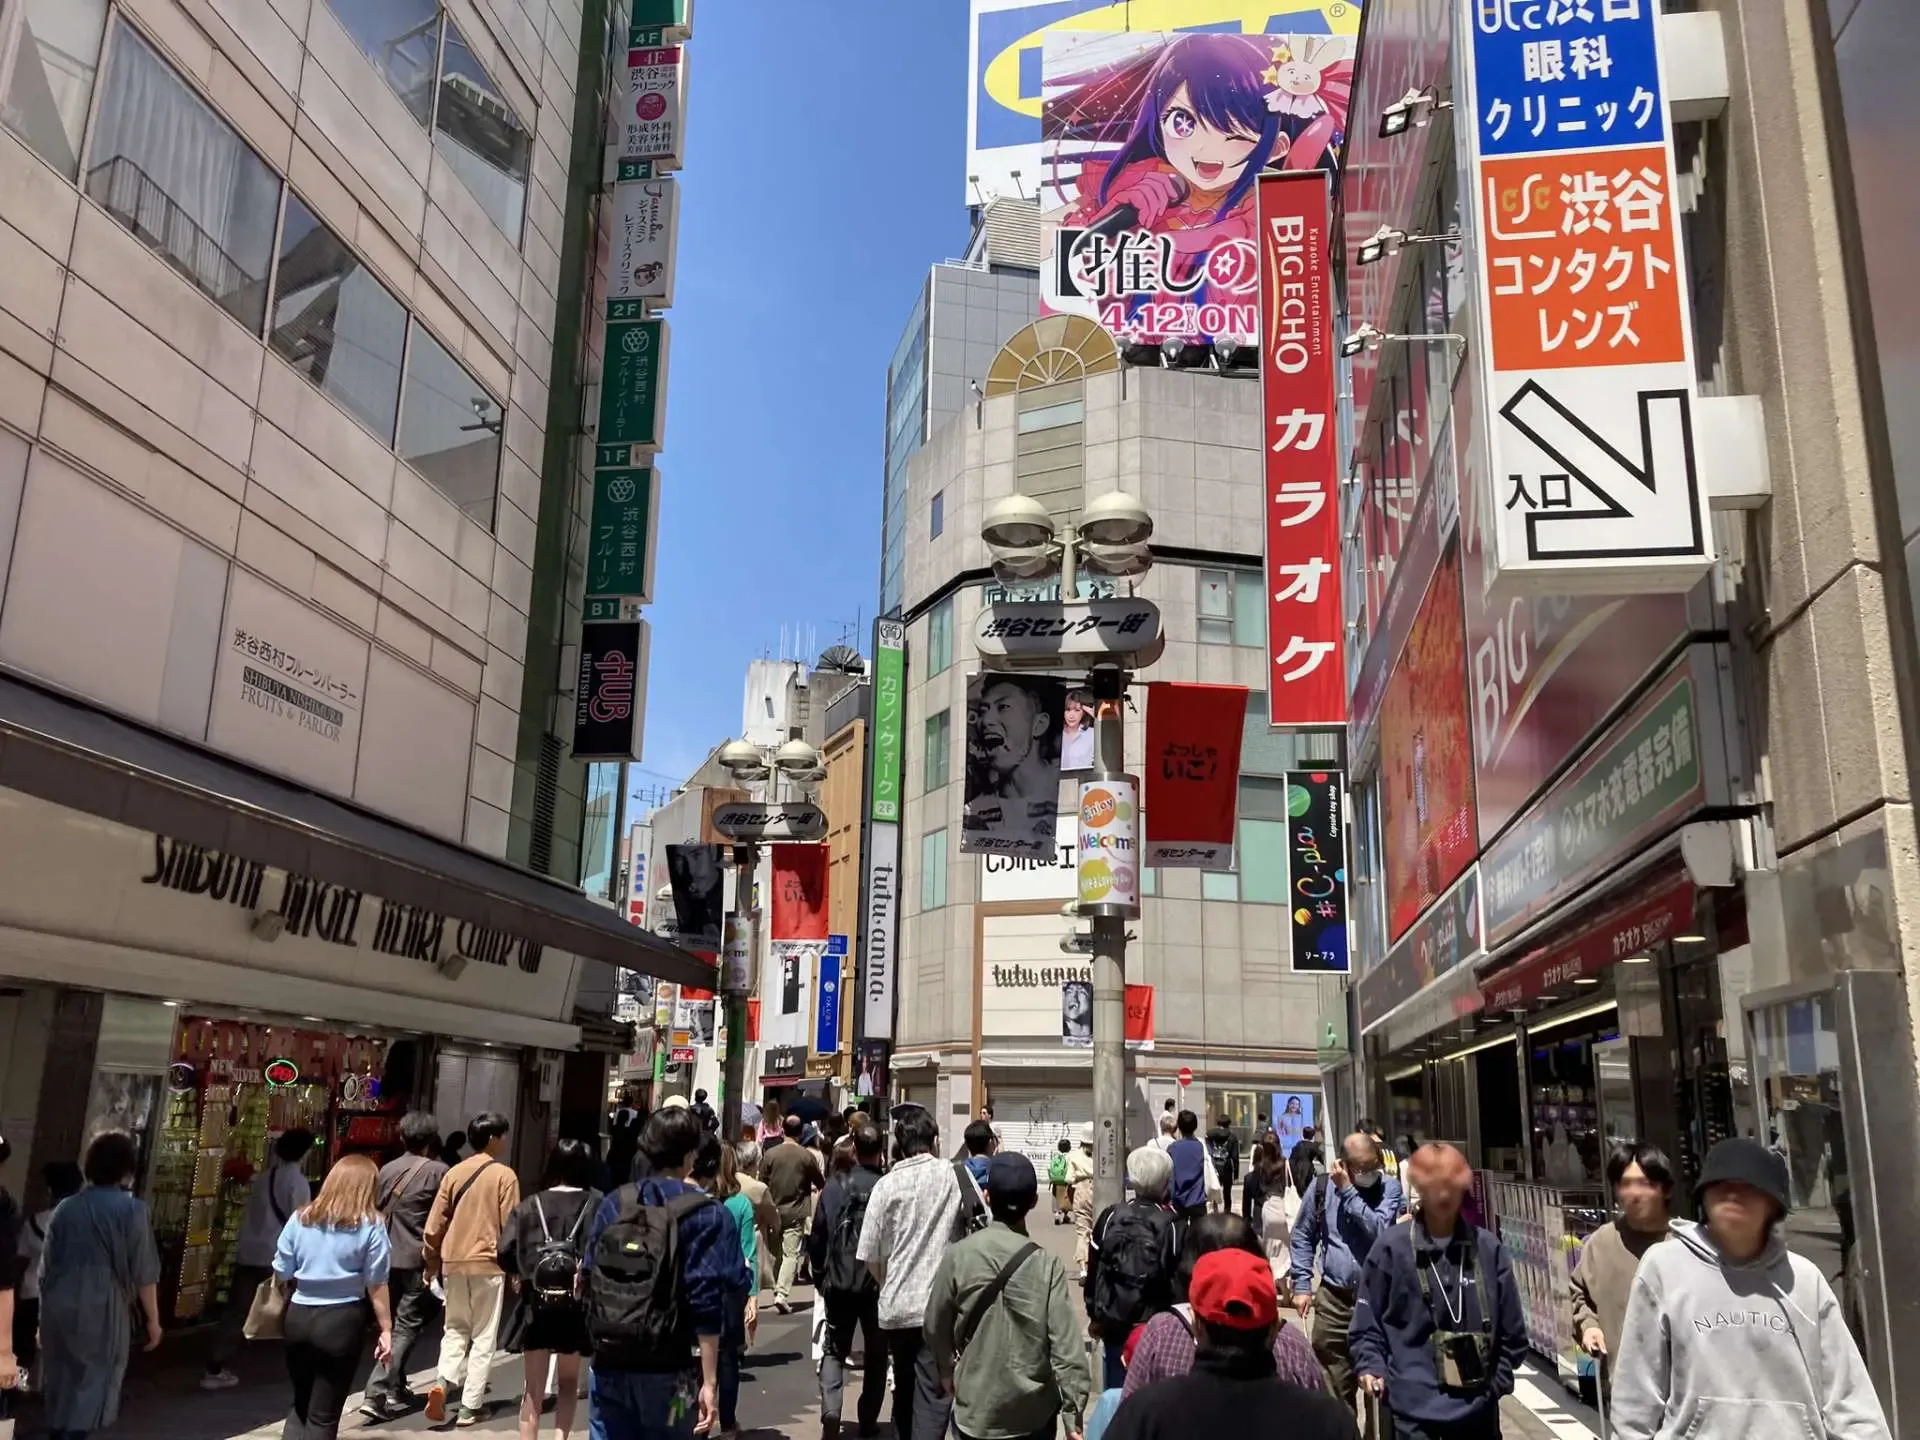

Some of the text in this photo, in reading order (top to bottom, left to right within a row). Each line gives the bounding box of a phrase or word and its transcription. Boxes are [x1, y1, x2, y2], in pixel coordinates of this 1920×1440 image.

[635, 32, 659, 45] 4F
[1523, 35, 1613, 82] 眼科
[631, 67, 659, 80] 渋谷
[631, 80, 676, 93] クリニック
[1486, 86, 1655, 141] クリニック
[625, 164, 648, 177] 3F
[1559, 167, 1664, 236] 渋谷
[1493, 243, 1671, 296] コンタクト
[613, 303, 638, 316] 2F
[1270, 215, 1309, 374] BIG ECHO
[1309, 227, 1322, 356] Karaoke Entertainment
[1538, 300, 1641, 352] レンズ
[603, 449, 627, 462] 1F
[1505, 474, 1573, 511] 入口
[596, 525, 614, 589] フルーツ
[618, 506, 640, 576] 渋谷西村
[1271, 408, 1336, 682] カラオケ
[591, 602, 615, 617] B1
[981, 613, 1150, 639] 渋谷センター街
[233, 627, 357, 700] 渋谷西村フルーツパーラー
[243, 667, 288, 700] SHIBUYA
[1475, 596, 1529, 769] BIG
[577, 653, 593, 726] BRITISH PUB
[589, 650, 634, 723] HUB
[240, 684, 284, 719] FRUITS
[298, 709, 341, 744] PARLOR
[1083, 797, 1115, 823] Enjoy
[1327, 785, 1338, 800] shop
[1328, 801, 1338, 813] toy
[719, 812, 816, 825] 渋谷センター街
[1079, 832, 1136, 851] Welcome
